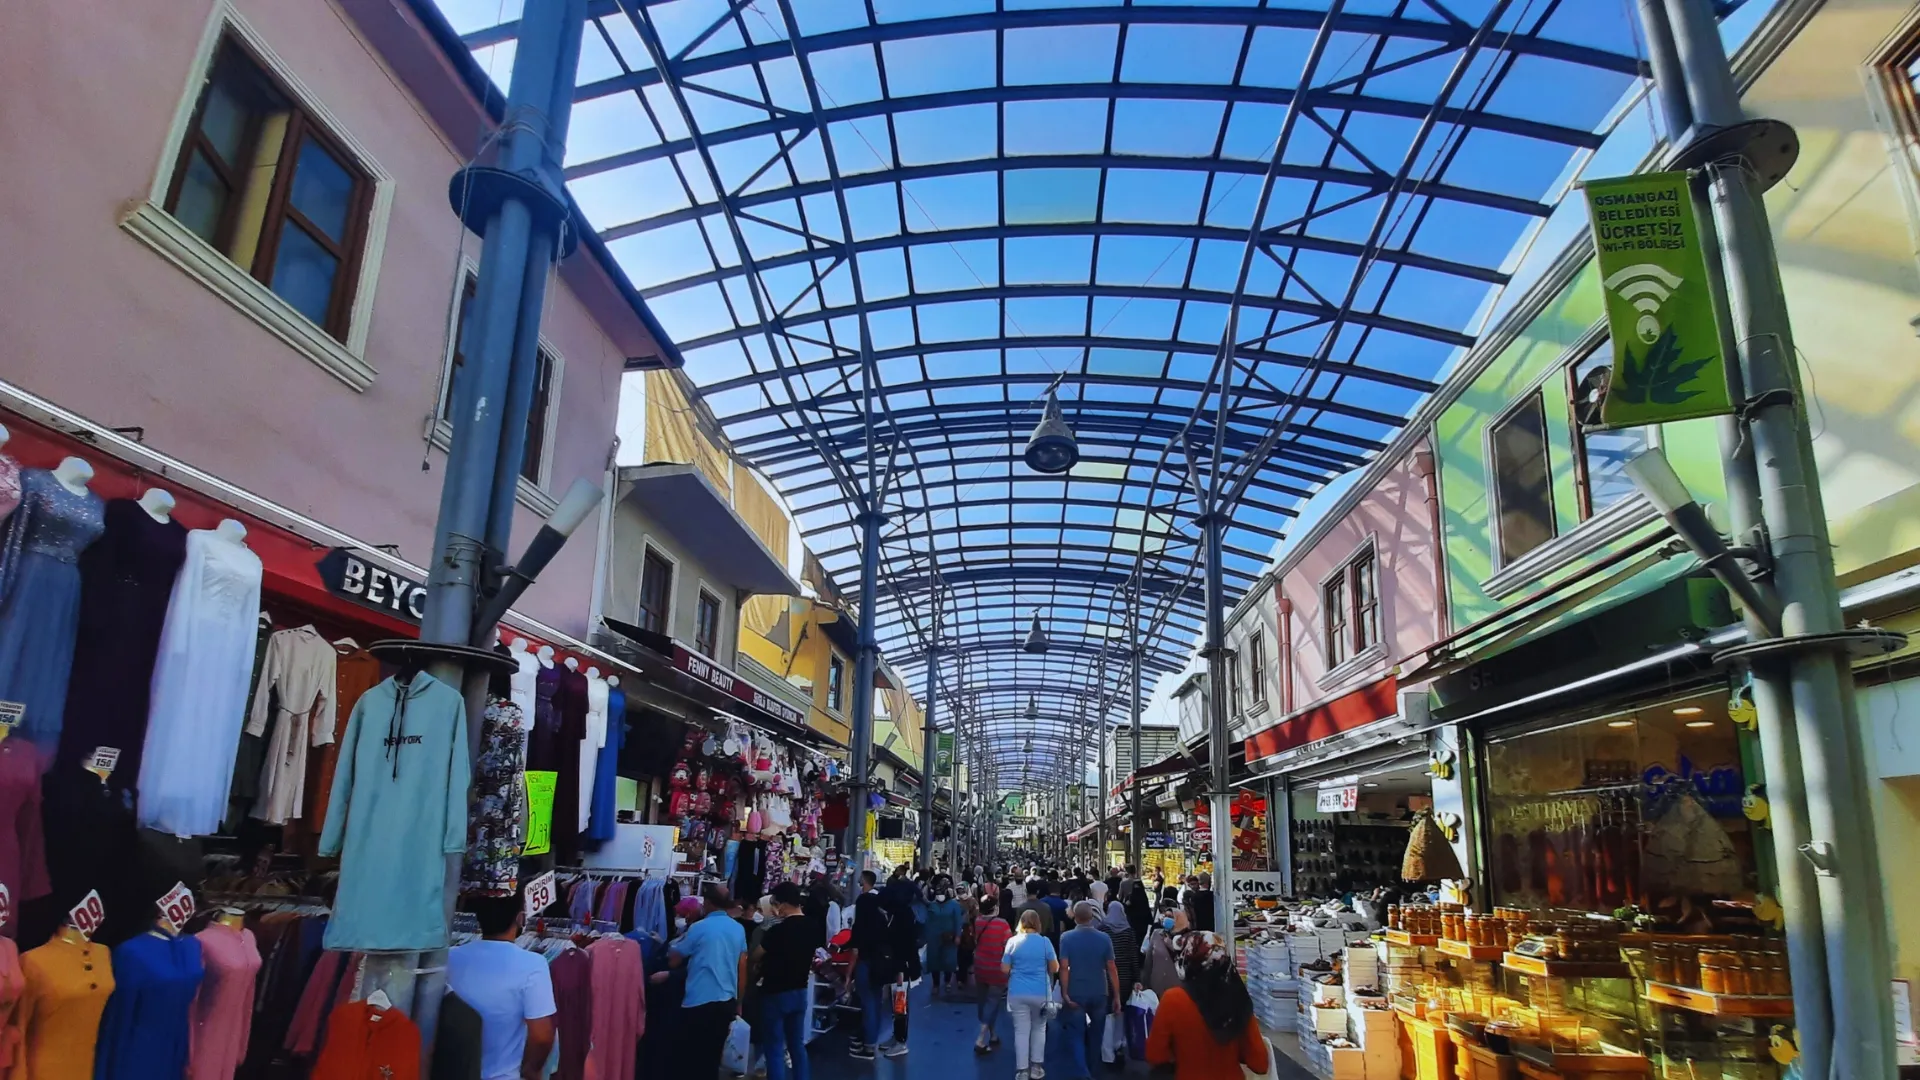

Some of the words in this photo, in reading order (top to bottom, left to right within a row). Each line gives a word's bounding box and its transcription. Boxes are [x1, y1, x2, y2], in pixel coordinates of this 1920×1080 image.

[1595, 187, 1678, 206] OSMANGAZİ
[1598, 203, 1680, 221] BELEDİYESİ
[1601, 219, 1683, 239] ÜCRETSİZ
[1637, 237, 1685, 250] BÖLGESİ
[687, 656, 710, 679] FENNY
[711, 669, 734, 692] BEAUTY
[95, 758, 112, 768] 150
[532, 886, 550, 912] 59
[167, 894, 194, 930] 99
